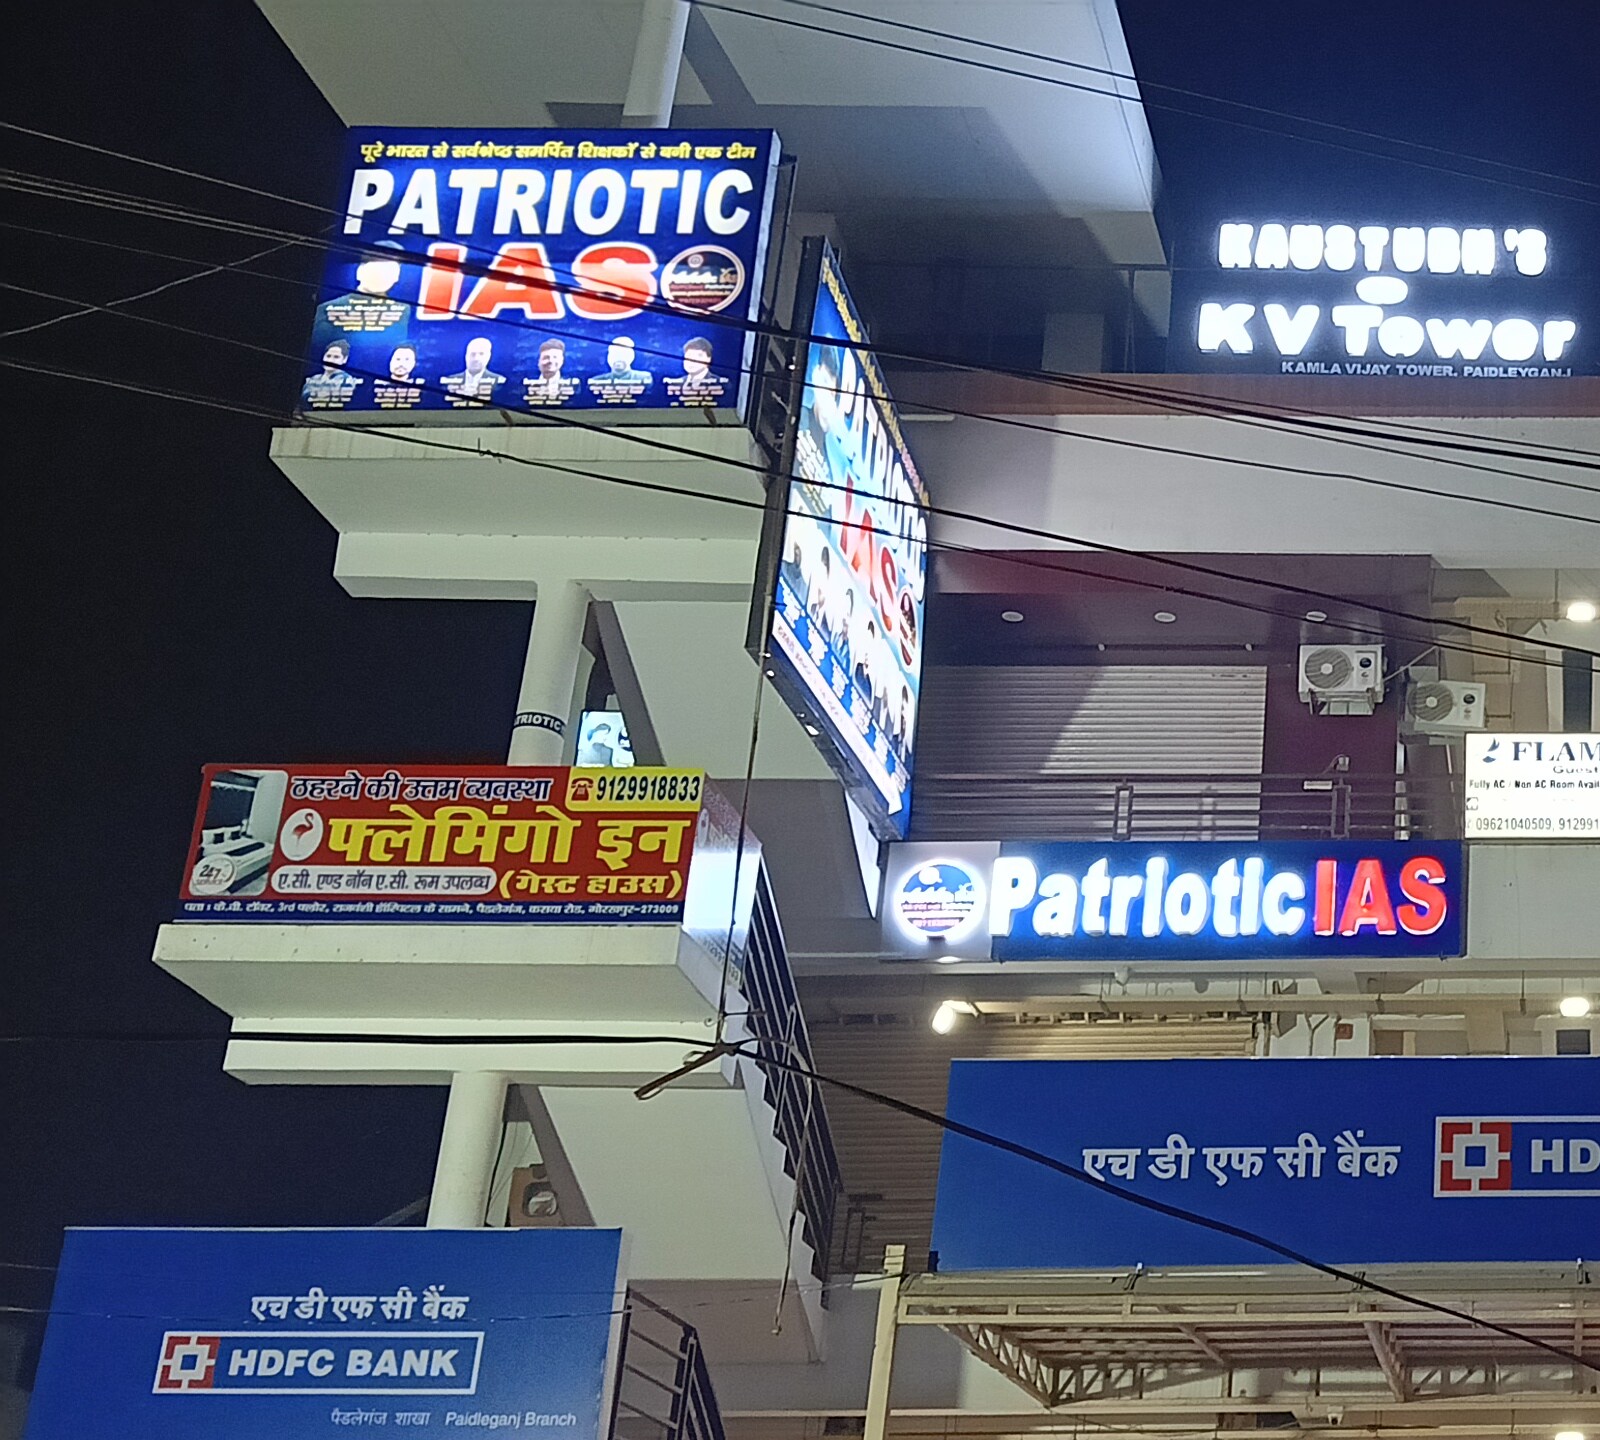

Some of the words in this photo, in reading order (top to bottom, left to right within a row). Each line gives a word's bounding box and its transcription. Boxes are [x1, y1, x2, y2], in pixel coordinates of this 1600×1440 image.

[360, 140, 384, 163] पूरे
[386, 144, 430, 159] भारत
[432, 140, 449, 159] से
[515, 140, 575, 159] समर्पित
[640, 142, 657, 159] से
[660, 142, 692, 159] बनी
[694, 146, 724, 160] एक
[726, 142, 757, 159] टीम
[343, 168, 754, 236] PATRIOTIC
[416, 241, 659, 321] IAS
[1332, 304, 1576, 361] Tower
[1280, 361, 1342, 375] KAMLA
[1346, 362, 1391, 376] VIJAY
[1463, 366, 1572, 378] PAIDLEYGANJ
[290, 771, 364, 800] ठहरने
[366, 770, 402, 800] की
[403, 778, 463, 801] उत्तम
[464, 778, 554, 801] व्यवस्था
[596, 775, 701, 801] 9129918833
[1469, 780, 1490, 790] Fully
[1493, 780, 1506, 789] AC
[1514, 780, 1532, 789] Non
[1534, 780, 1547, 789] AC
[1550, 780, 1575, 789] Room
[328, 804, 582, 864] फ्लेमिंगो
[596, 820, 692, 871] इन
[278, 868, 311, 890] ए.सी.
[316, 874, 343, 891] एण्ड
[345, 870, 374, 890] नॉन
[375, 869, 409, 890] ए.सी.
[414, 875, 439, 891] रूम
[499, 869, 580, 900] (गेस्ट
[586, 869, 683, 900] हाउस)
[278, 901, 296, 912] 3rd
[988, 856, 1306, 938] Patriotic
[1314, 857, 1447, 936] IAS
[1081, 1147, 1141, 1182] एच
[1147, 1133, 1195, 1180] डी
[1202, 1147, 1267, 1186] एफ
[1273, 1132, 1326, 1179] सी
[1333, 1129, 1402, 1178] बैंक
[251, 1296, 293, 1321] एच
[294, 1287, 329, 1320] डी
[331, 1296, 377, 1322] एफ
[379, 1286, 417, 1320] सी
[422, 1284, 470, 1320] बैंक
[227, 1347, 335, 1377] HDFC
[345, 1347, 459, 1377] BANK
[330, 1407, 387, 1426] पैडलेगंज
[395, 1411, 431, 1426] शाखा
[445, 1411, 521, 1429] Paidleganj
[524, 1411, 577, 1426] Branch
